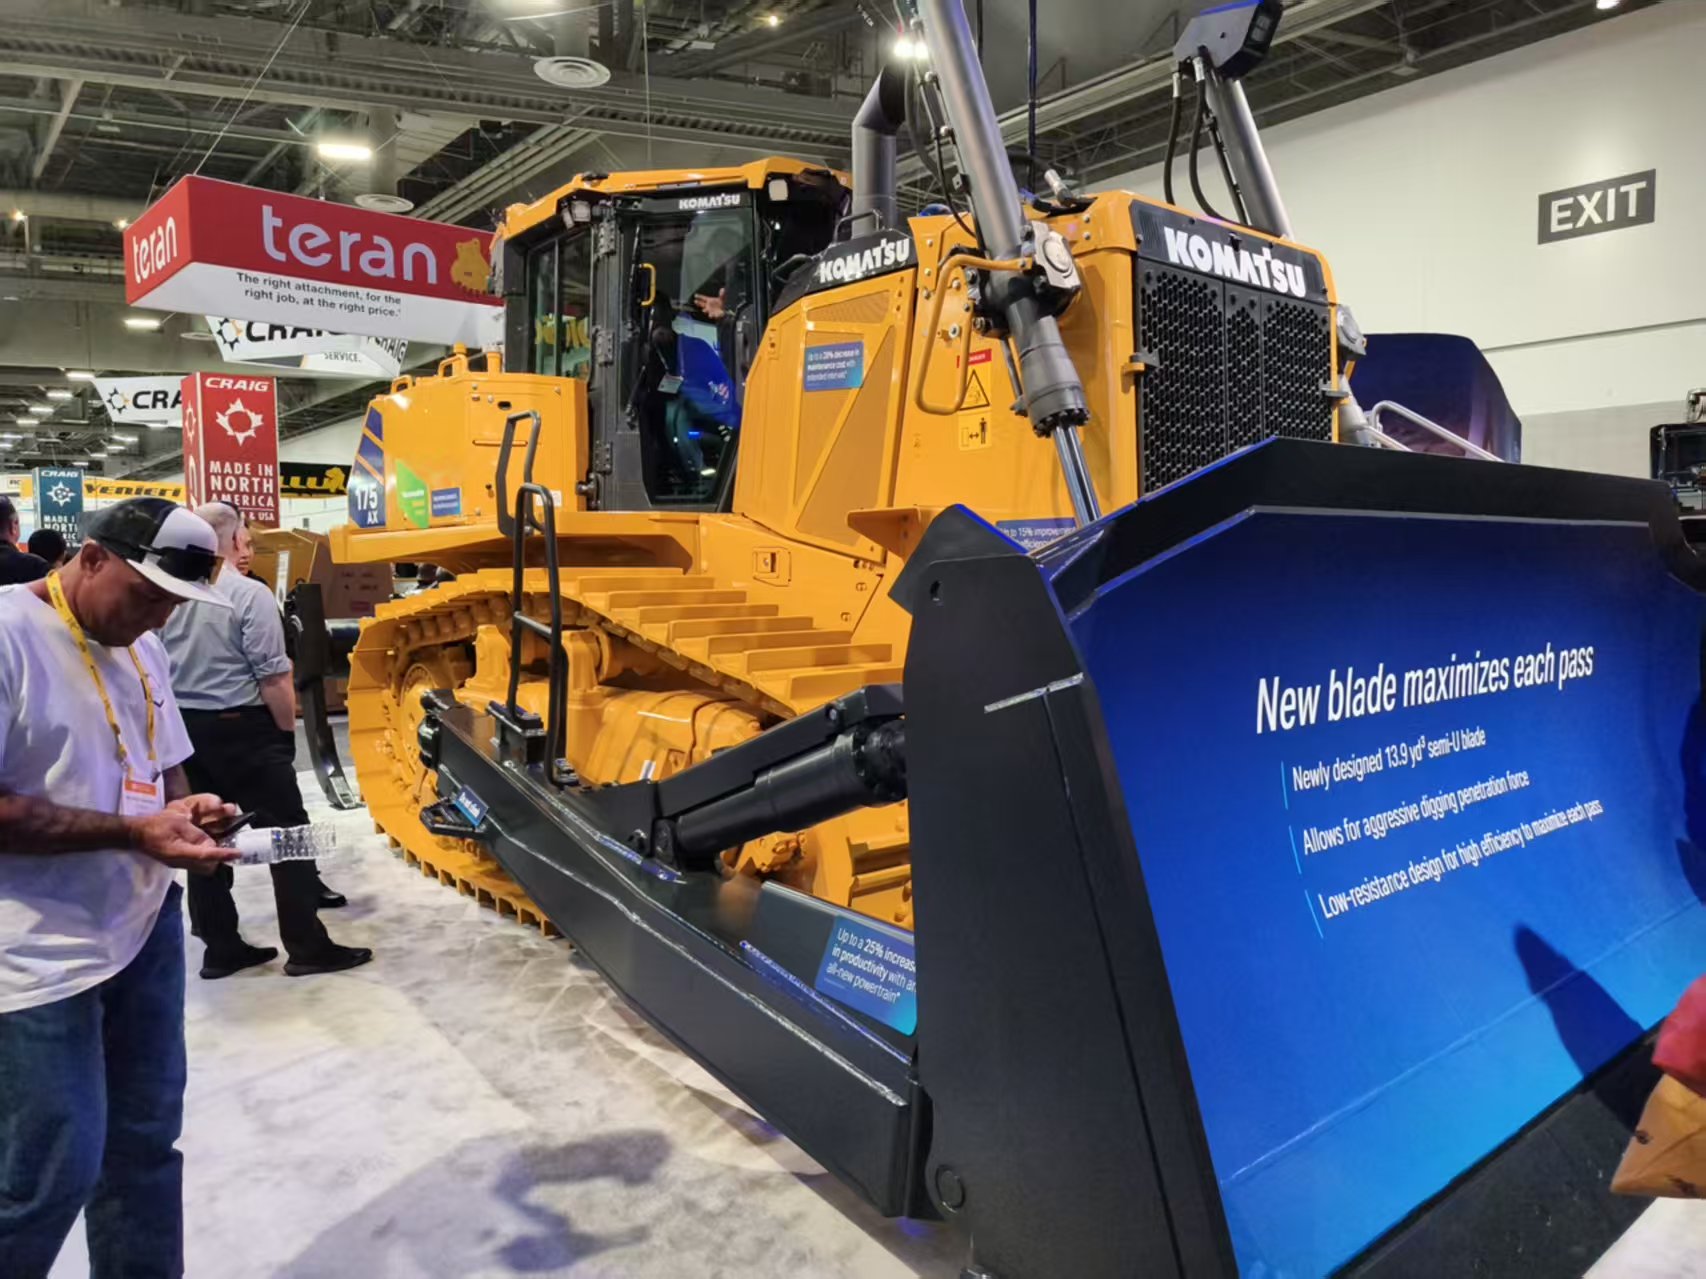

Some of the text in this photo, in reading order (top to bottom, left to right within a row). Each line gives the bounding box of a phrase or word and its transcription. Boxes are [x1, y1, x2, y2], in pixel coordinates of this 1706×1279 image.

[679, 193, 741, 209] KOMATSU
[1550, 181, 1647, 233] EXIT
[132, 216, 178, 285] teran
[262, 204, 438, 285] teran
[819, 238, 910, 284] KOMATSU
[1164, 226, 1307, 298] KOMATSU
[236, 272, 401, 305] The right attachment, for the
[244, 288, 273, 301] right
[276, 294, 299, 305] job,
[302, 297, 314, 306] at
[318, 299, 336, 309] the
[339, 302, 365, 313] right
[324, 352, 362, 363] SERVICE.
[205, 377, 270, 393] CRAIG
[41, 470, 79, 478] CRAIG
[210, 461, 274, 477] MADE IN
[210, 476, 274, 493] NORTH
[355, 483, 379, 511] 175
[211, 493, 275, 508] AMERICA
[43, 514, 68, 523] MADE
[258, 512, 275, 521] USA
[367, 511, 379, 525] AX
[1257, 642, 1594, 734] New blade maximizes each pass
[1292, 761, 1330, 791] Newly
[1333, 748, 1383, 782] designed
[1385, 742, 1408, 769] 13.9
[1428, 731, 1460, 758] semi-U
[1461, 726, 1486, 750] blade
[1303, 770, 1530, 856] Allows for aggressive digging penetration force
[1318, 799, 1604, 919] Low-resistance design for high efficiency to maximize each pass
[837, 928, 917, 973] Up to a 25% increas
[826, 961, 855, 982] all-new
[832, 943, 841, 958] in
[840, 949, 889, 982] productivity
[888, 971, 907, 988] with
